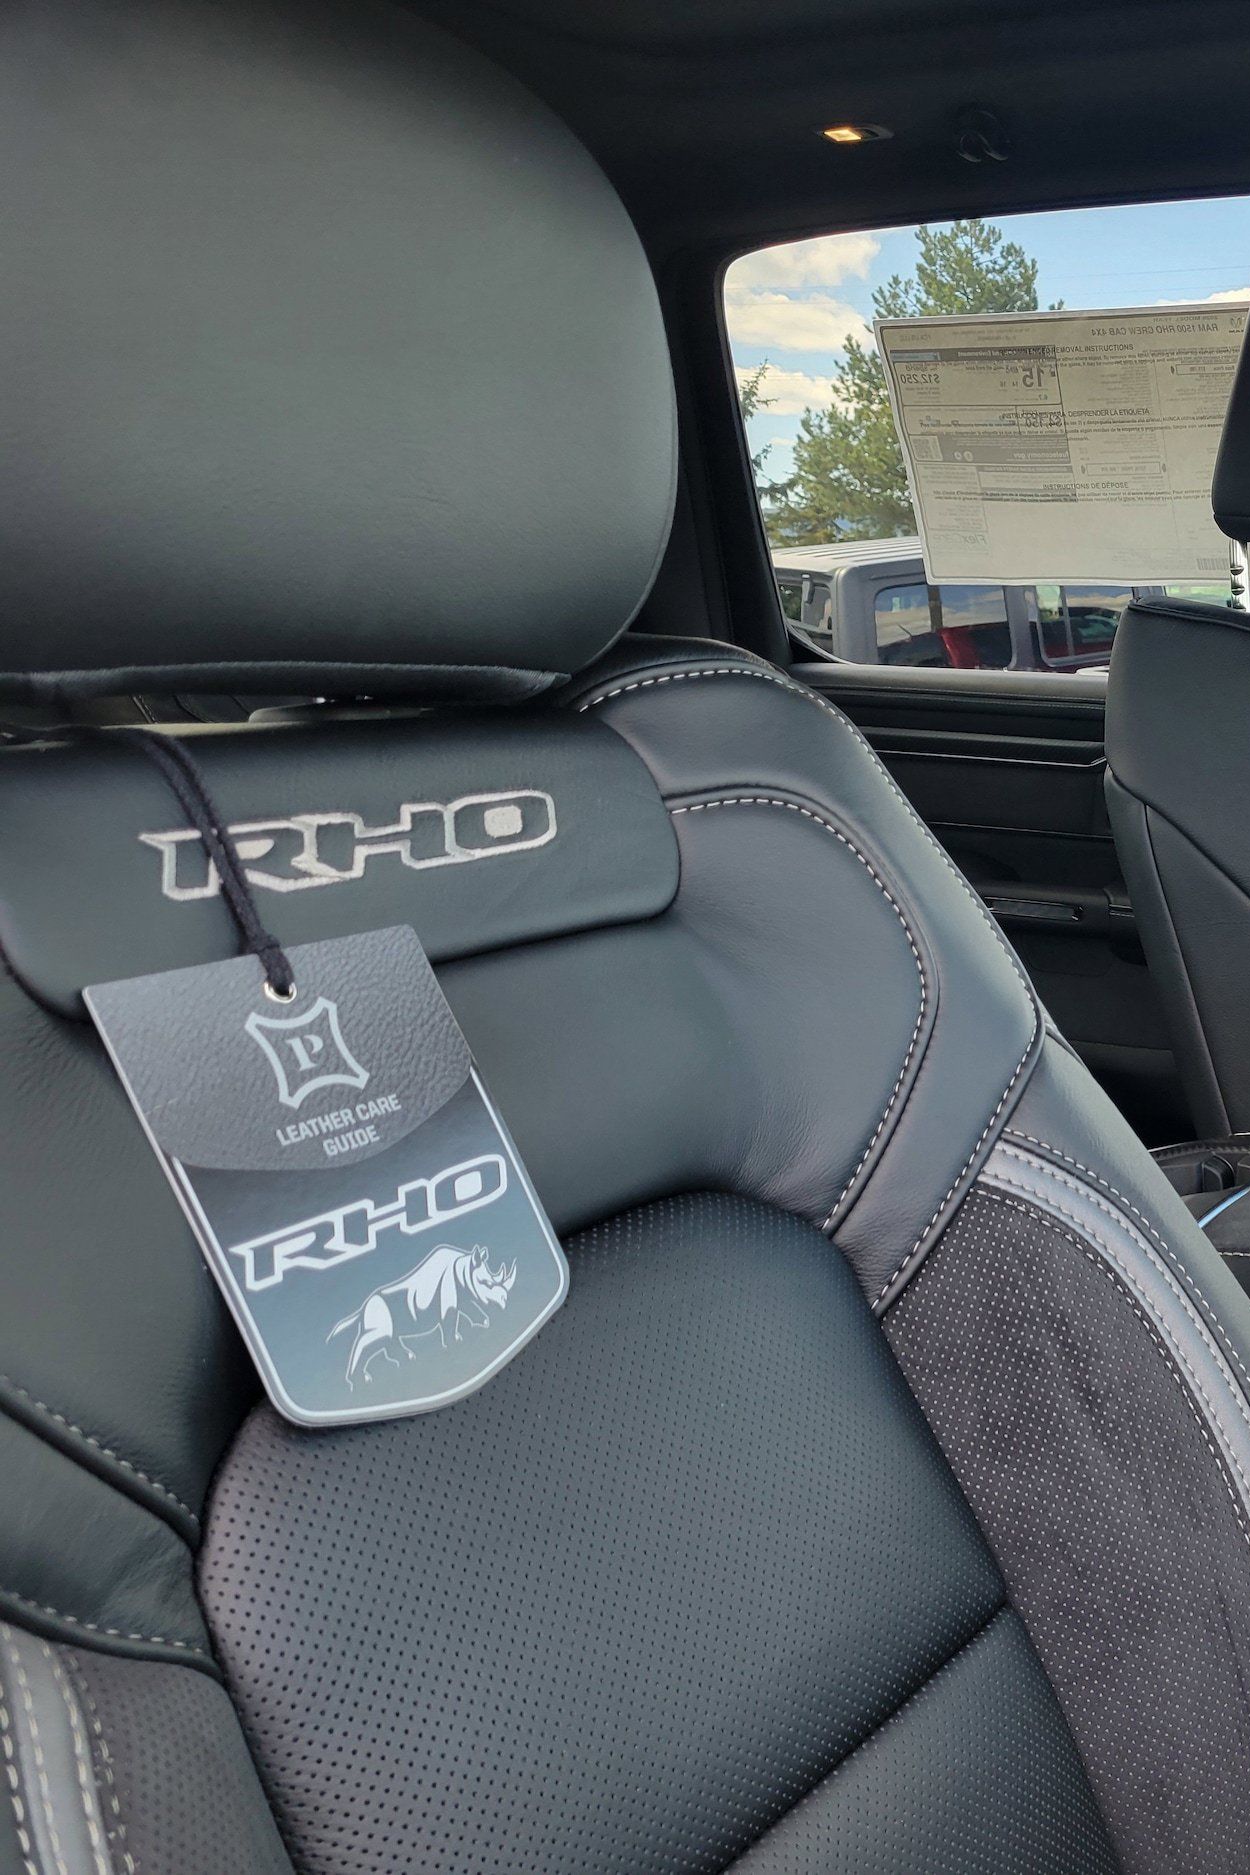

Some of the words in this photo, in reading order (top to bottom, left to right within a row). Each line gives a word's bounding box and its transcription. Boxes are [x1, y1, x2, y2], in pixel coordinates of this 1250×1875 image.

[1051, 345, 1083, 354] REMOVAL
[1085, 343, 1134, 352] INSTRUCTIONS
[1068, 409, 1110, 418] DESPRENDER
[1119, 408, 1150, 416] ETIQUETA
[1043, 482, 1090, 490] INSTRUCTIONS
[138, 789, 557, 901] RHO
[284, 1033, 325, 1073] P
[275, 1108, 356, 1148] LEATHER
[354, 1093, 403, 1125] CARE
[321, 1127, 380, 1160] GUIDE
[230, 1153, 508, 1292] RHO
